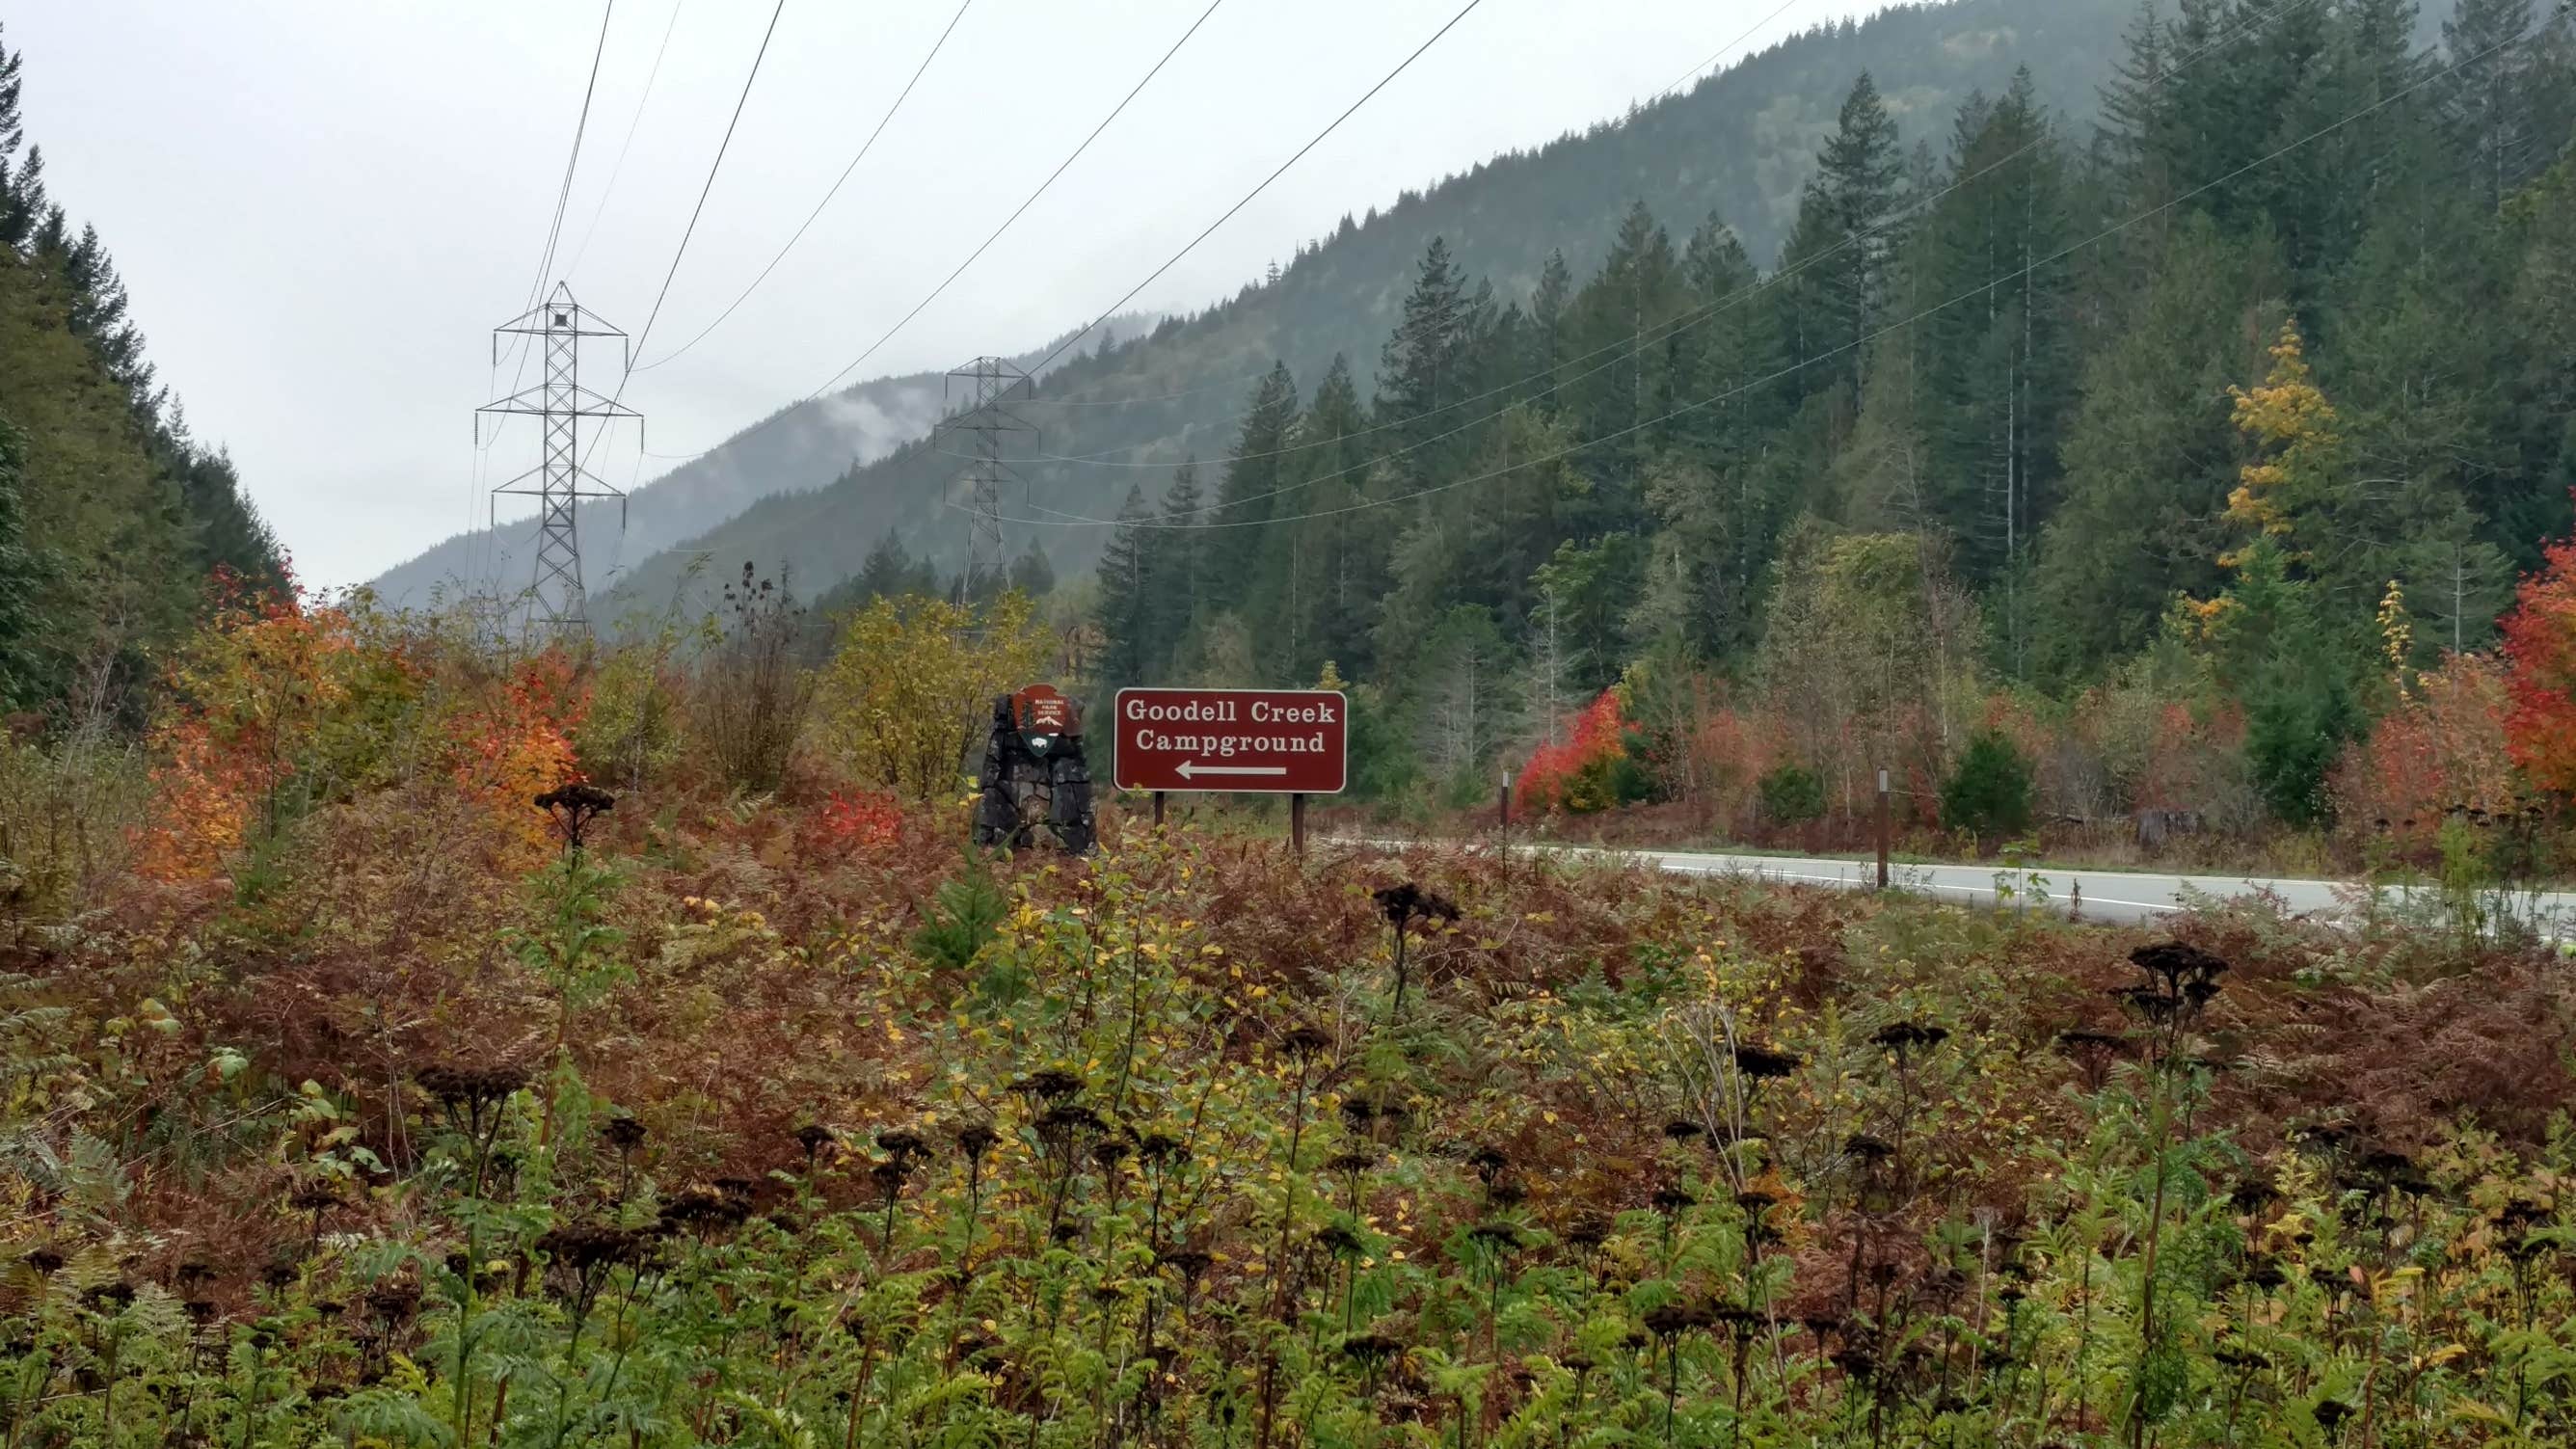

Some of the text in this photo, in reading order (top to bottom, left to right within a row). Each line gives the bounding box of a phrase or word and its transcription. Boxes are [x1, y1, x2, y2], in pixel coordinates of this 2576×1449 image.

[1126, 699, 1336, 723] Goodell Creek
[1136, 730, 1326, 757] Campground
